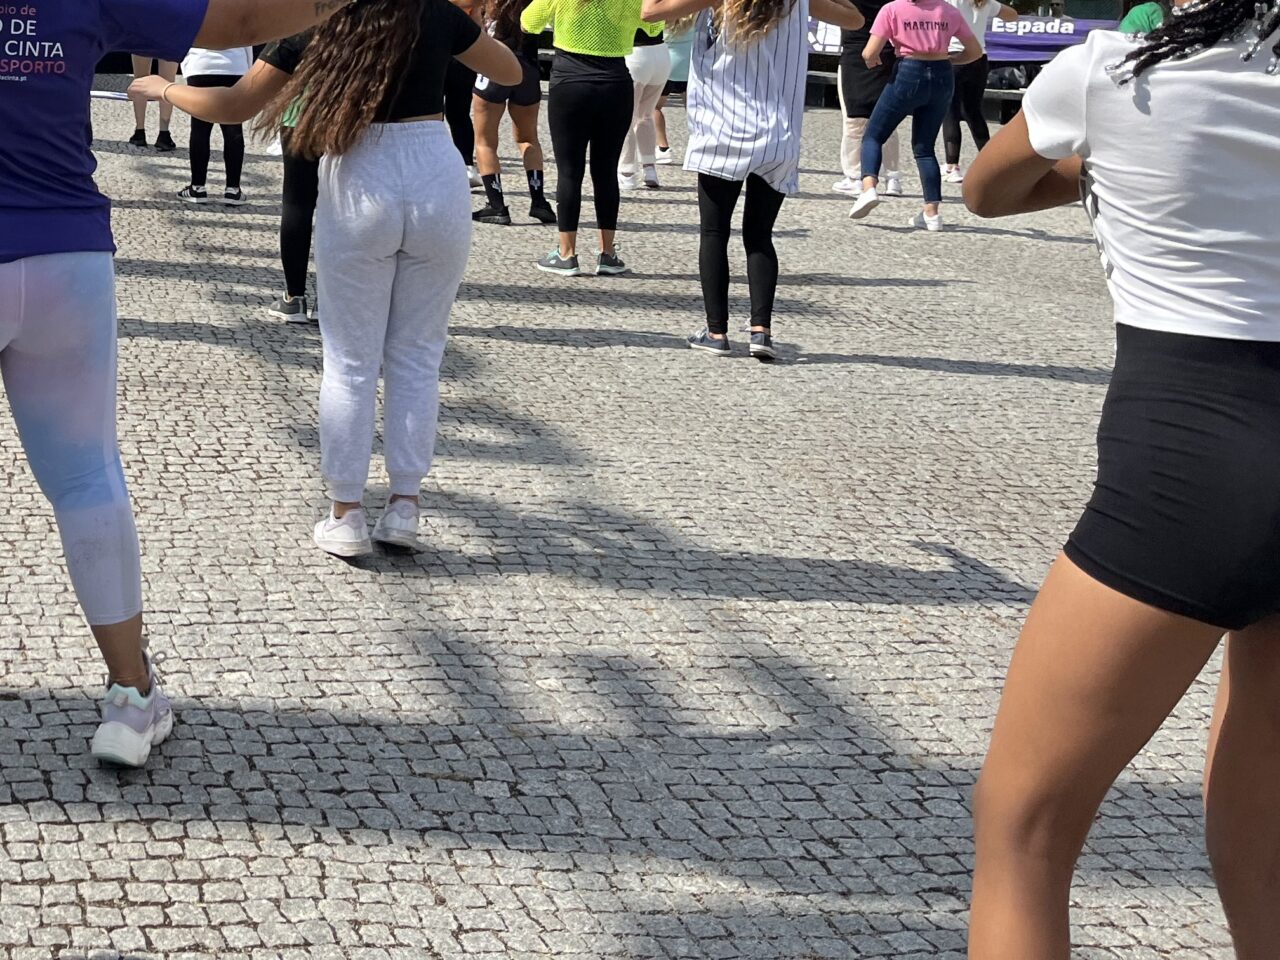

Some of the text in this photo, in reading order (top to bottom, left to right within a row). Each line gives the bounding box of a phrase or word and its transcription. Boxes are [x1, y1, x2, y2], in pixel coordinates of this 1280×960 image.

[20, 4, 36, 16] de
[11, 18, 37, 36] DE
[991, 17, 1075, 36] Espada
[5, 40, 64, 58] CINTA
